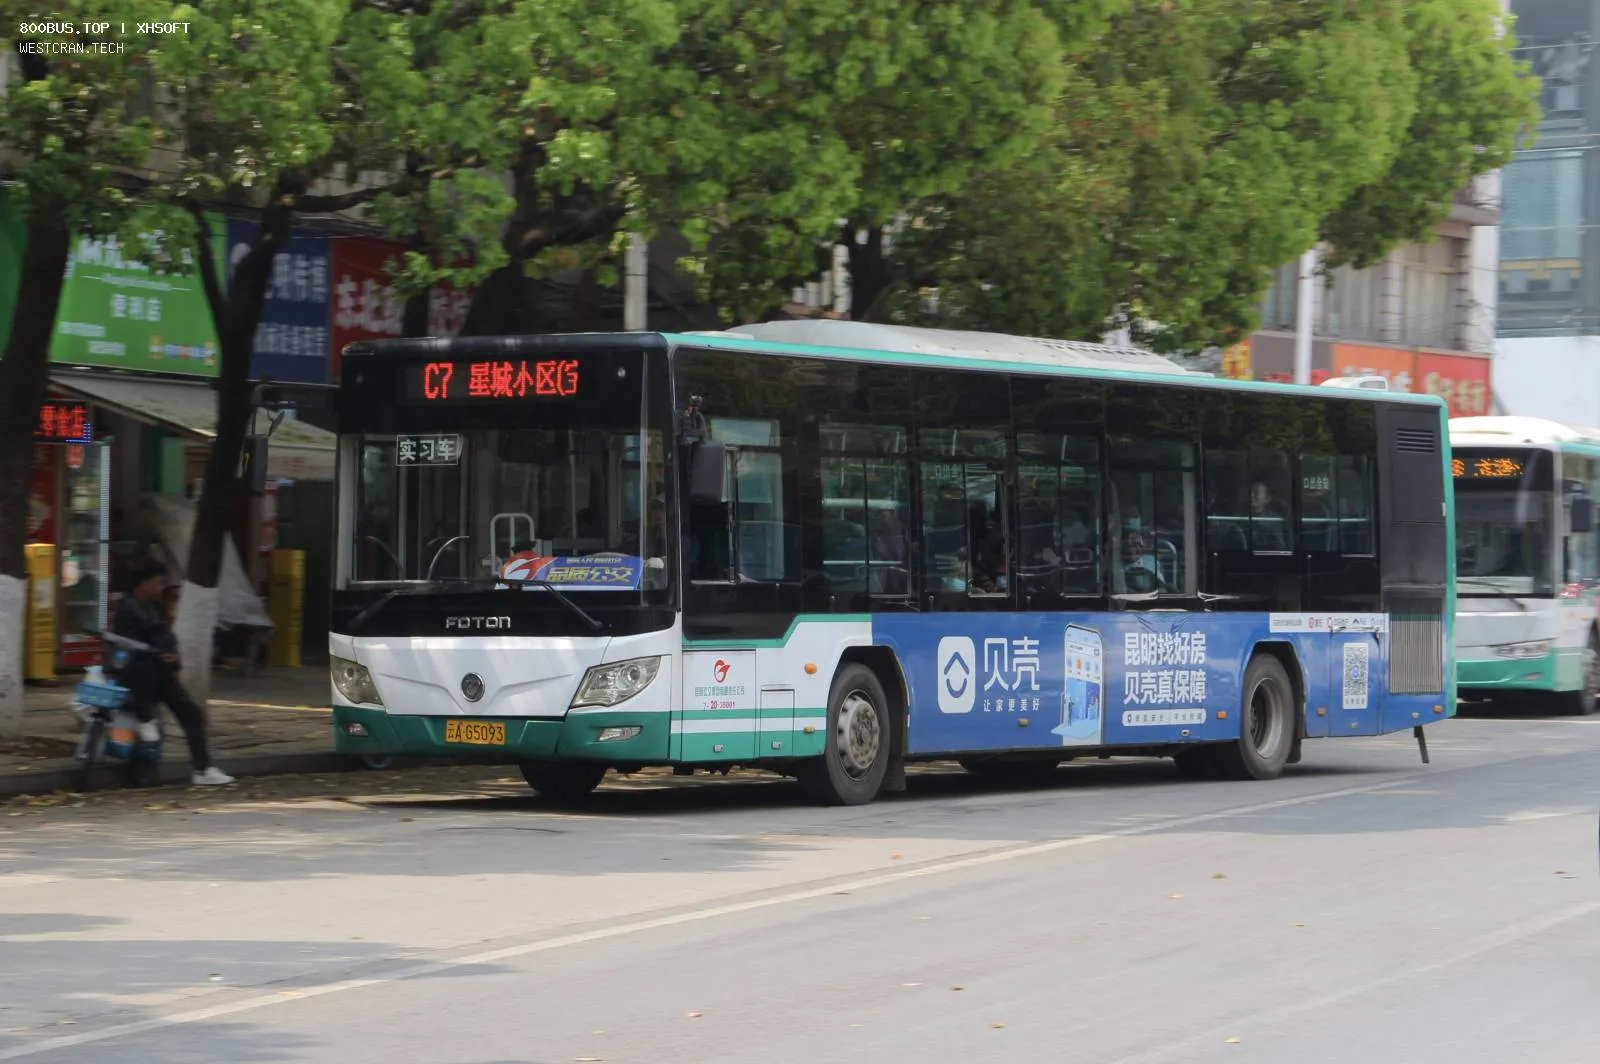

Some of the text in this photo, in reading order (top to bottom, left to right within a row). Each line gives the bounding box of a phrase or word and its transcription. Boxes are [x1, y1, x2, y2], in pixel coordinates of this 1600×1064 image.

[423, 362, 453, 399] C7
[399, 438, 459, 462] 实习车
[546, 566, 634, 583] 品质公交
[445, 616, 511, 629] FOTON
[1124, 631, 1207, 666] 昆明找好房
[983, 635, 1041, 692] 贝壳
[1123, 669, 1207, 705] 贝壳真保障
[983, 698, 1040, 713] 让家更美好
